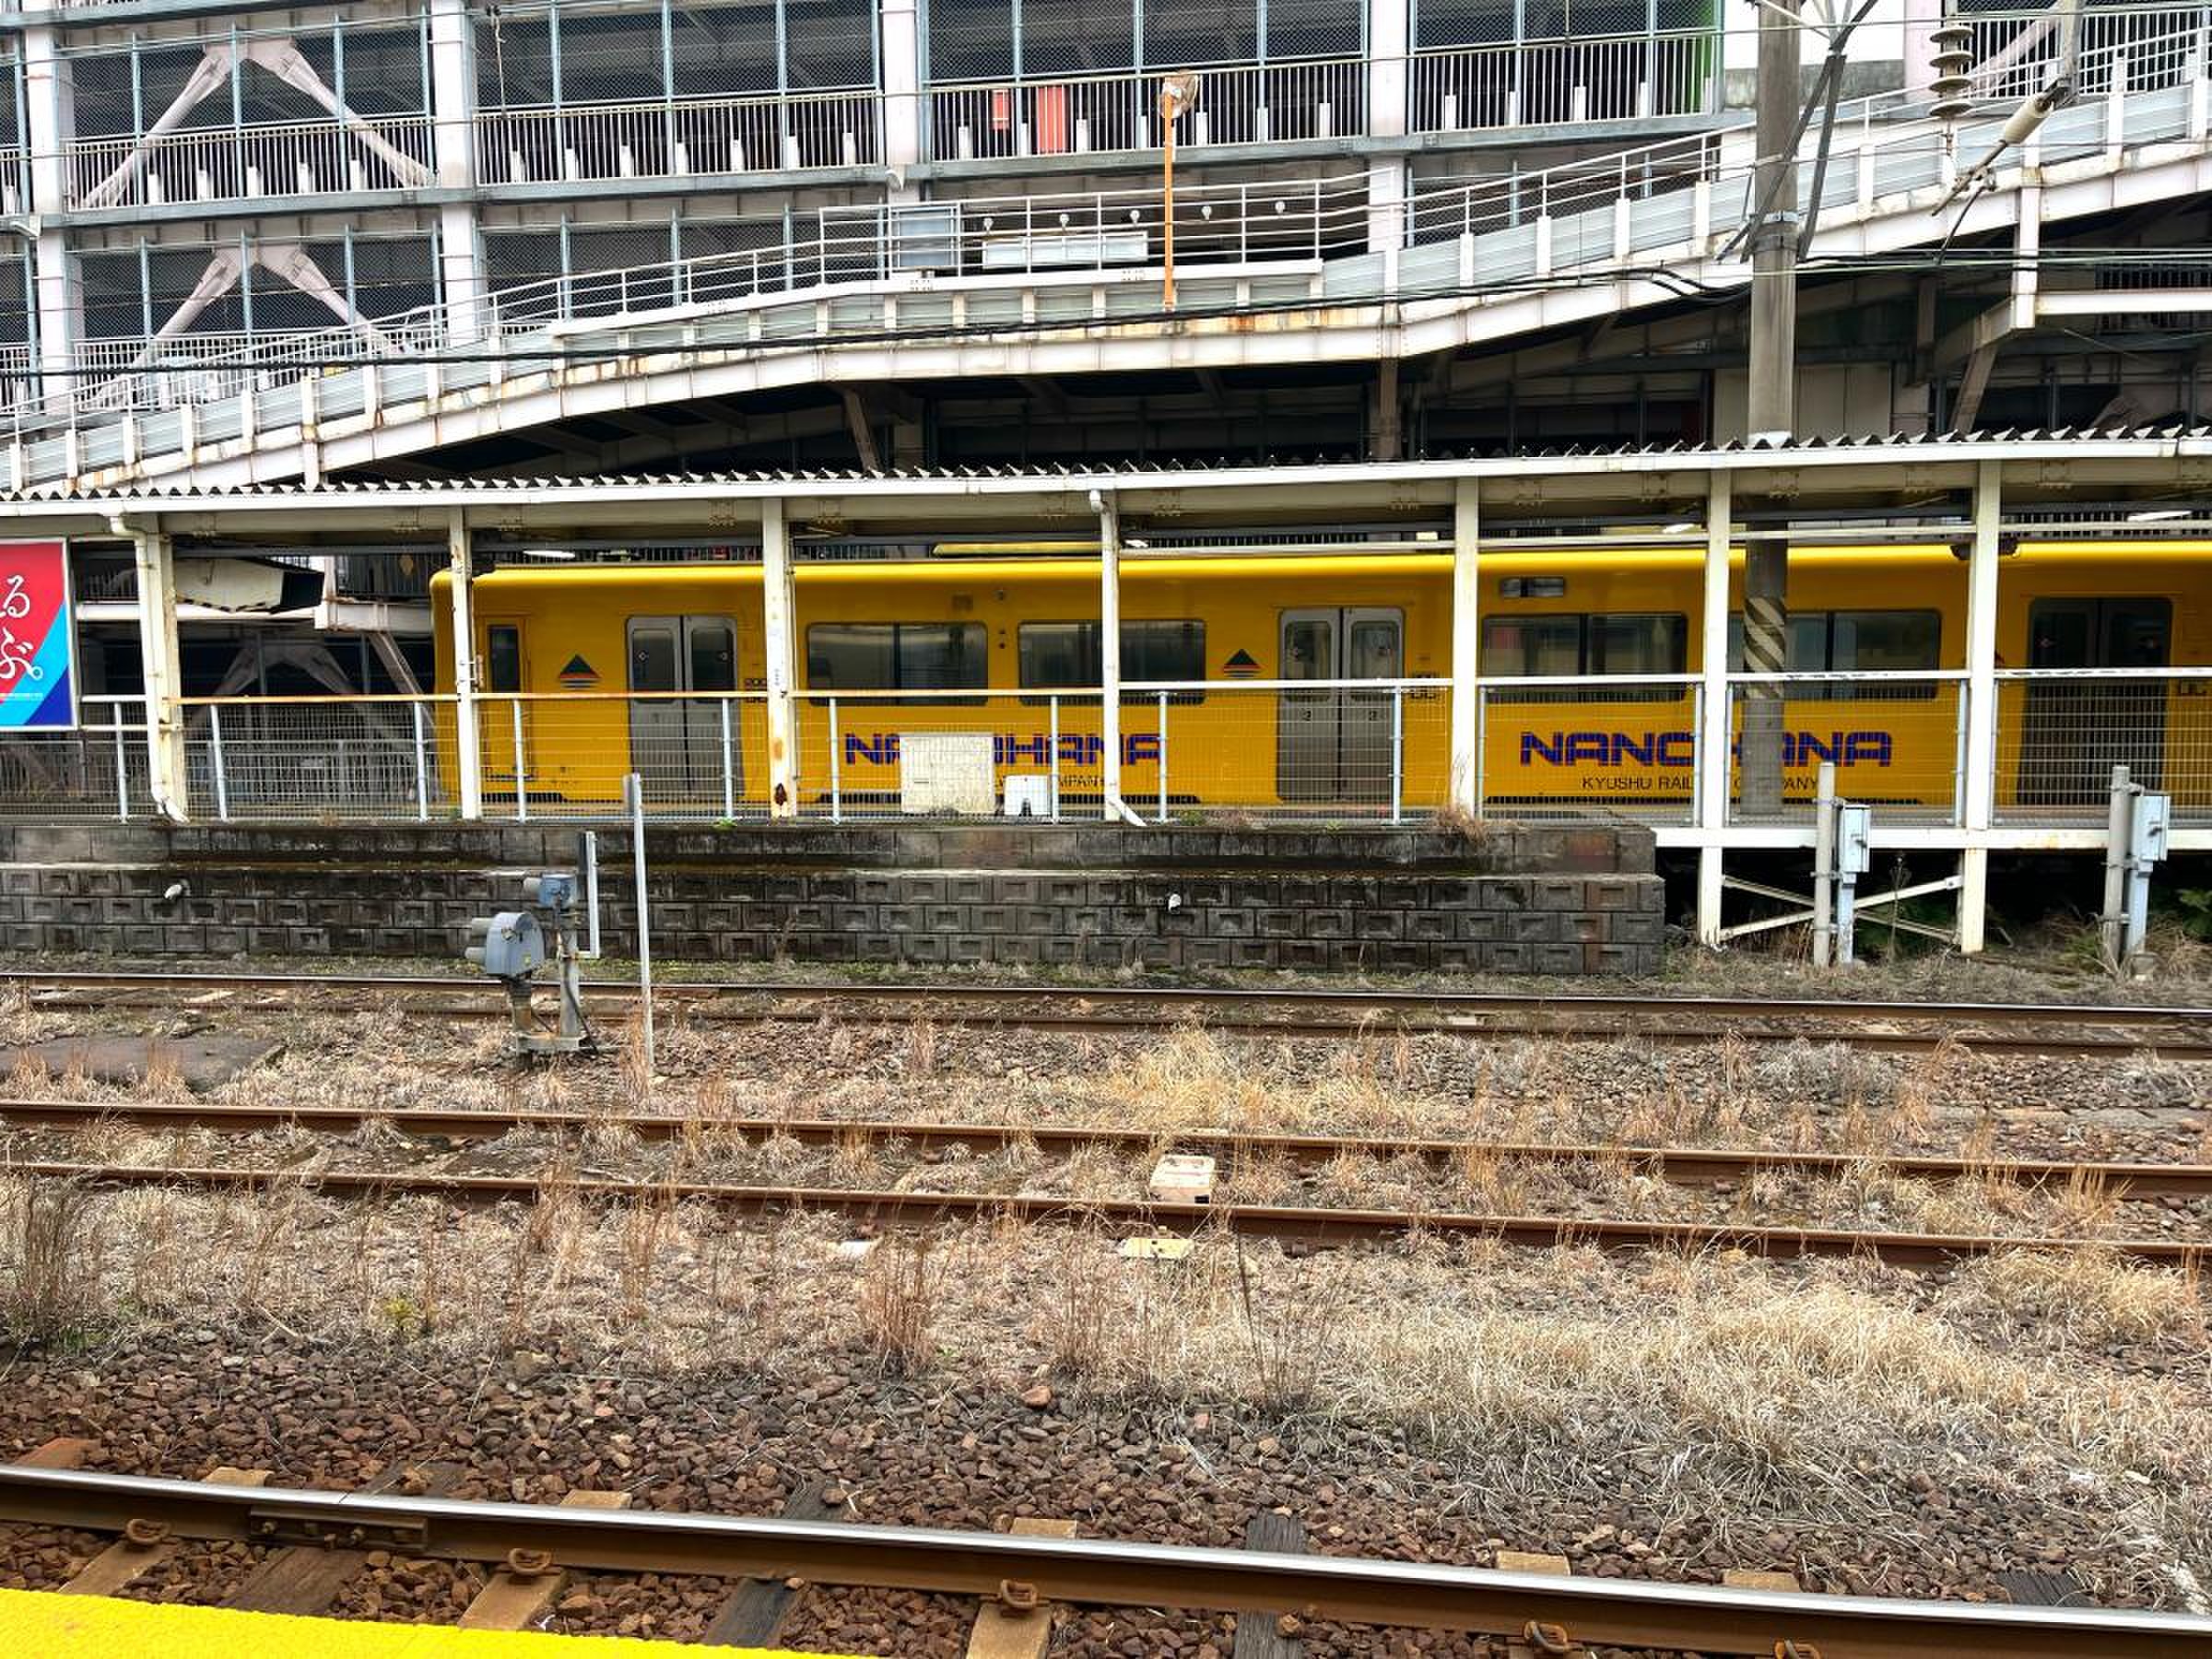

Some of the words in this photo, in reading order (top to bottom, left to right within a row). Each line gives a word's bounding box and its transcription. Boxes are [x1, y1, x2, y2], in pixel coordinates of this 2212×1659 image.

[0, 575, 30, 618] る
[845, 733, 1160, 765] NHANA
[1520, 732, 1892, 766] NANONA
[1582, 776, 1653, 790] KYUSHU
[1658, 776, 1694, 790] RAIL
[1734, 777, 1818, 790] CANY
